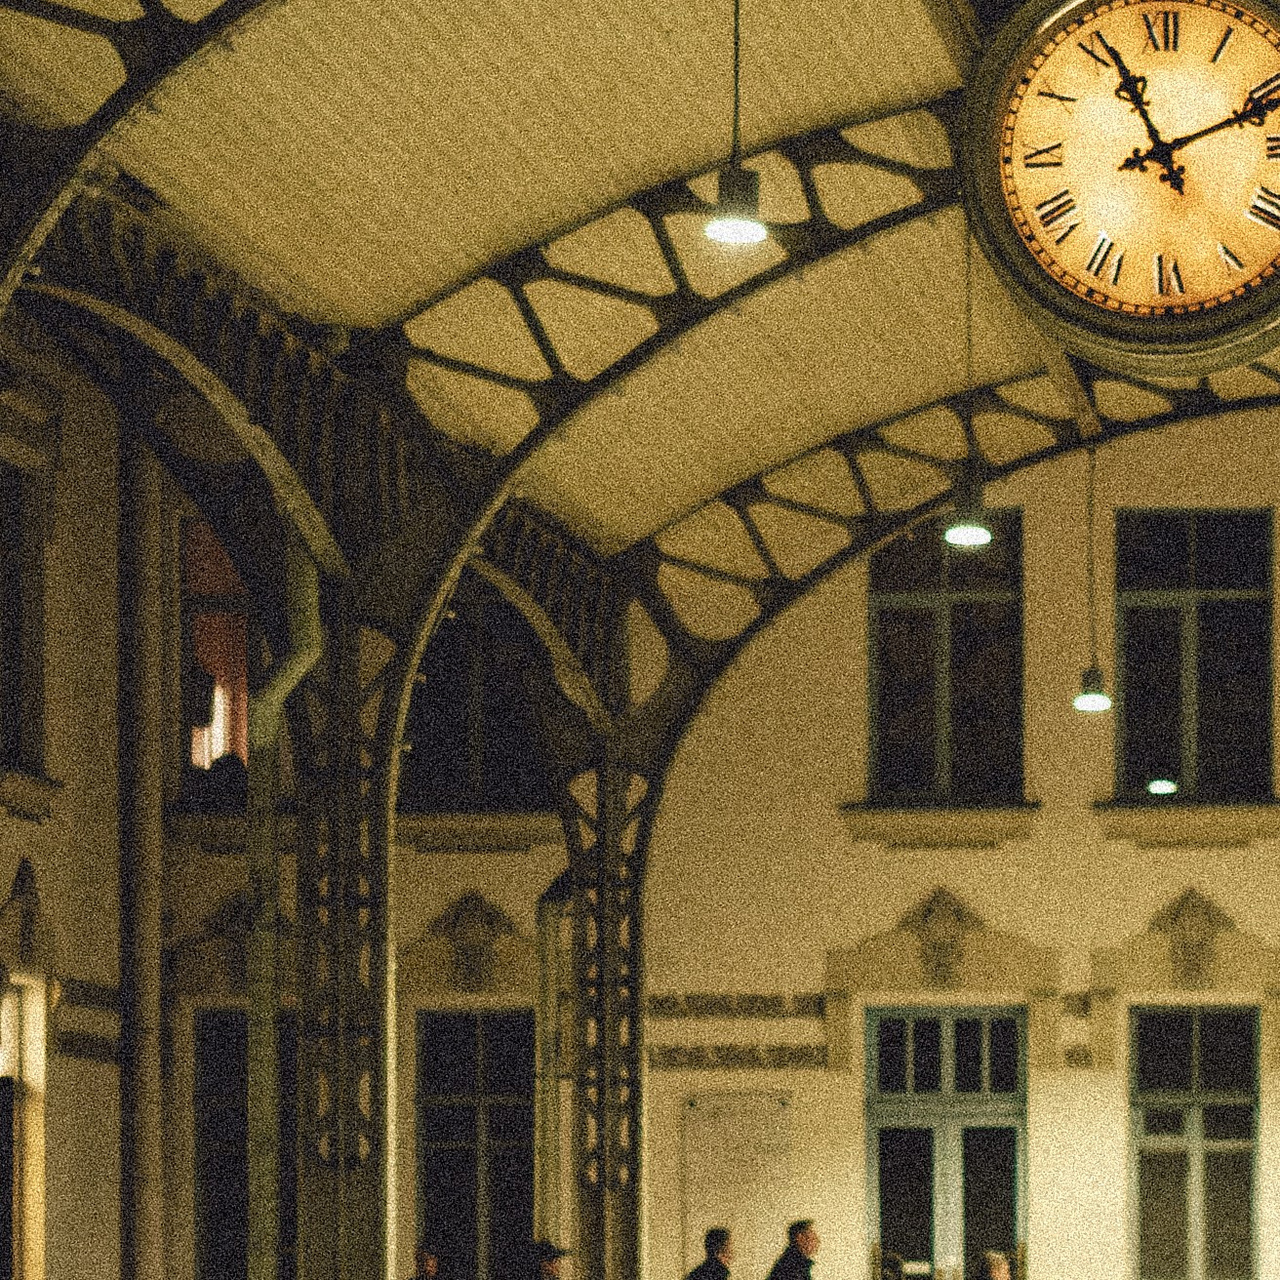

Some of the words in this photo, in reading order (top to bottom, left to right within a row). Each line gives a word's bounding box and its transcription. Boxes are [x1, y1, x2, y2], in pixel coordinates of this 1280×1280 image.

[1142, 10, 1179, 54] XII
[1210, 25, 1234, 64] I
[1022, 140, 1064, 168] IX
[1036, 188, 1081, 246] VIII
[1085, 237, 1125, 286] VII
[1156, 253, 1186, 296] VI
